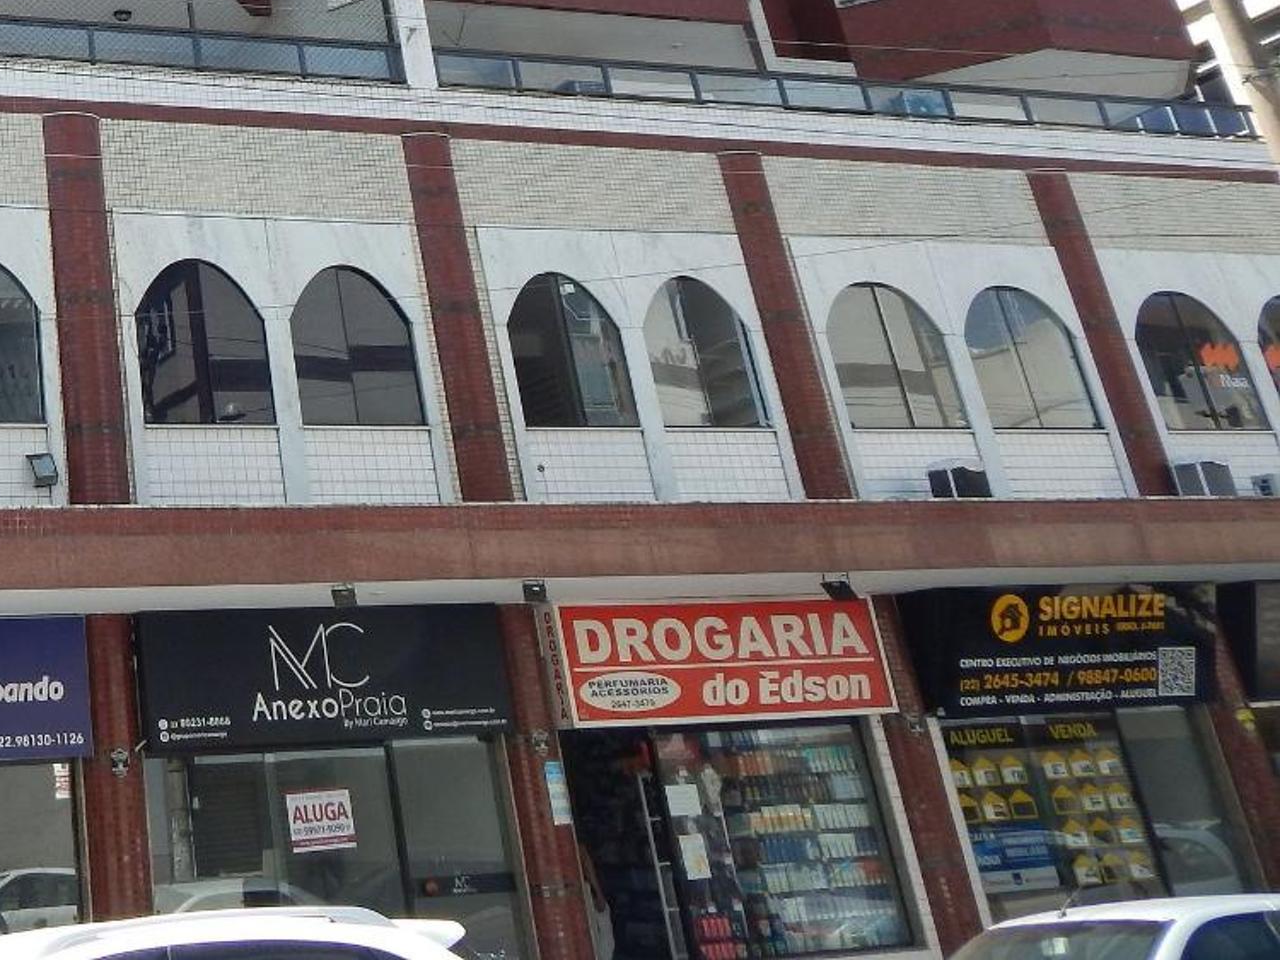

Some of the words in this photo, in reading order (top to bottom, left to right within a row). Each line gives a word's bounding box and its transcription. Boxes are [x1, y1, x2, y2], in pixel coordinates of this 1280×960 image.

[1038, 594, 1166, 621] SIGNALIZE
[572, 613, 870, 664] DROGARIA
[1038, 621, 1111, 637] IMÓVEIS
[268, 621, 370, 691] MC
[543, 611, 569, 720] DROGARIA
[959, 657, 994, 668] CENTRO
[1043, 655, 1055, 666] DE
[587, 678, 669, 689] PERFUMARIA
[702, 673, 750, 706] do
[759, 669, 870, 705] Edson
[983, 671, 1059, 690] 2645-3474
[949, 728, 1014, 746] ALUGUEL
[1049, 721, 1098, 740] VENDA
[292, 801, 349, 825] ALUGA
